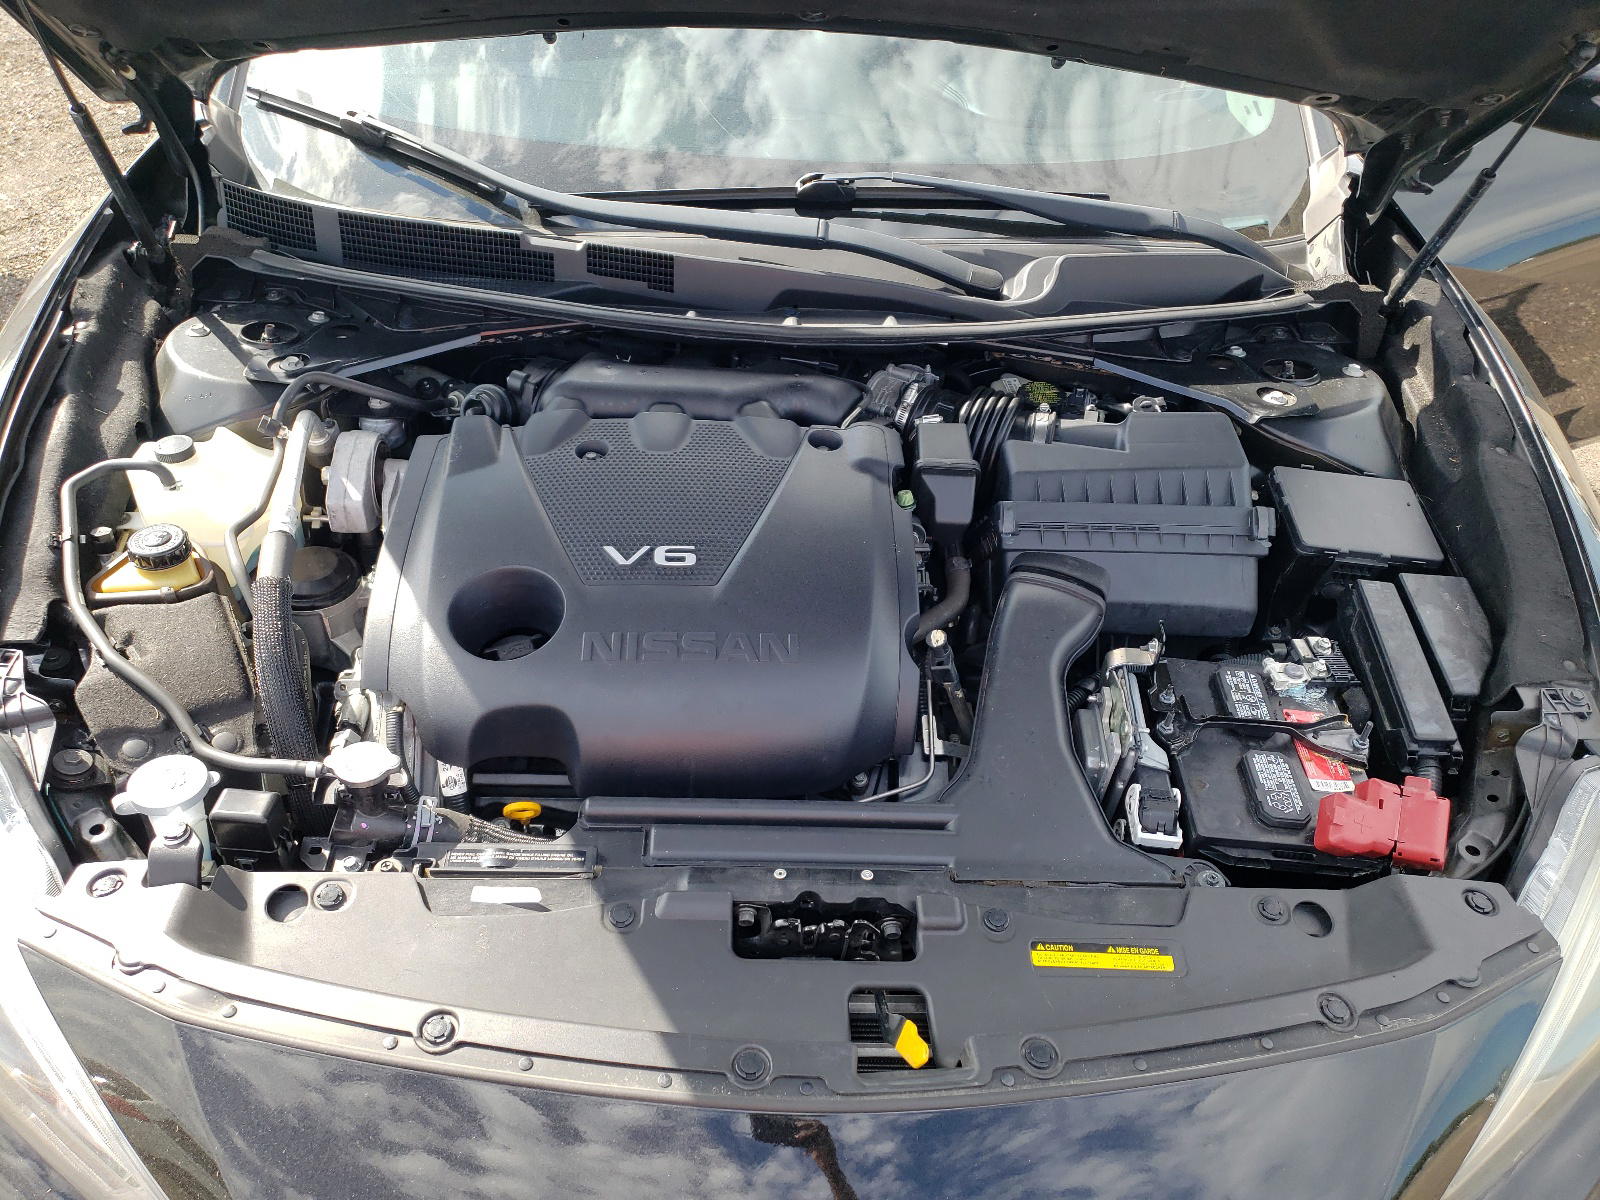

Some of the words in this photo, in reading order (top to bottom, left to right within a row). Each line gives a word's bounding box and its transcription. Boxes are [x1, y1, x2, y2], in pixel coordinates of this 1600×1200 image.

[603, 545, 696, 566] V6
[581, 631, 799, 665] NISSAN
[1045, 944, 1074, 952] CAUTION
